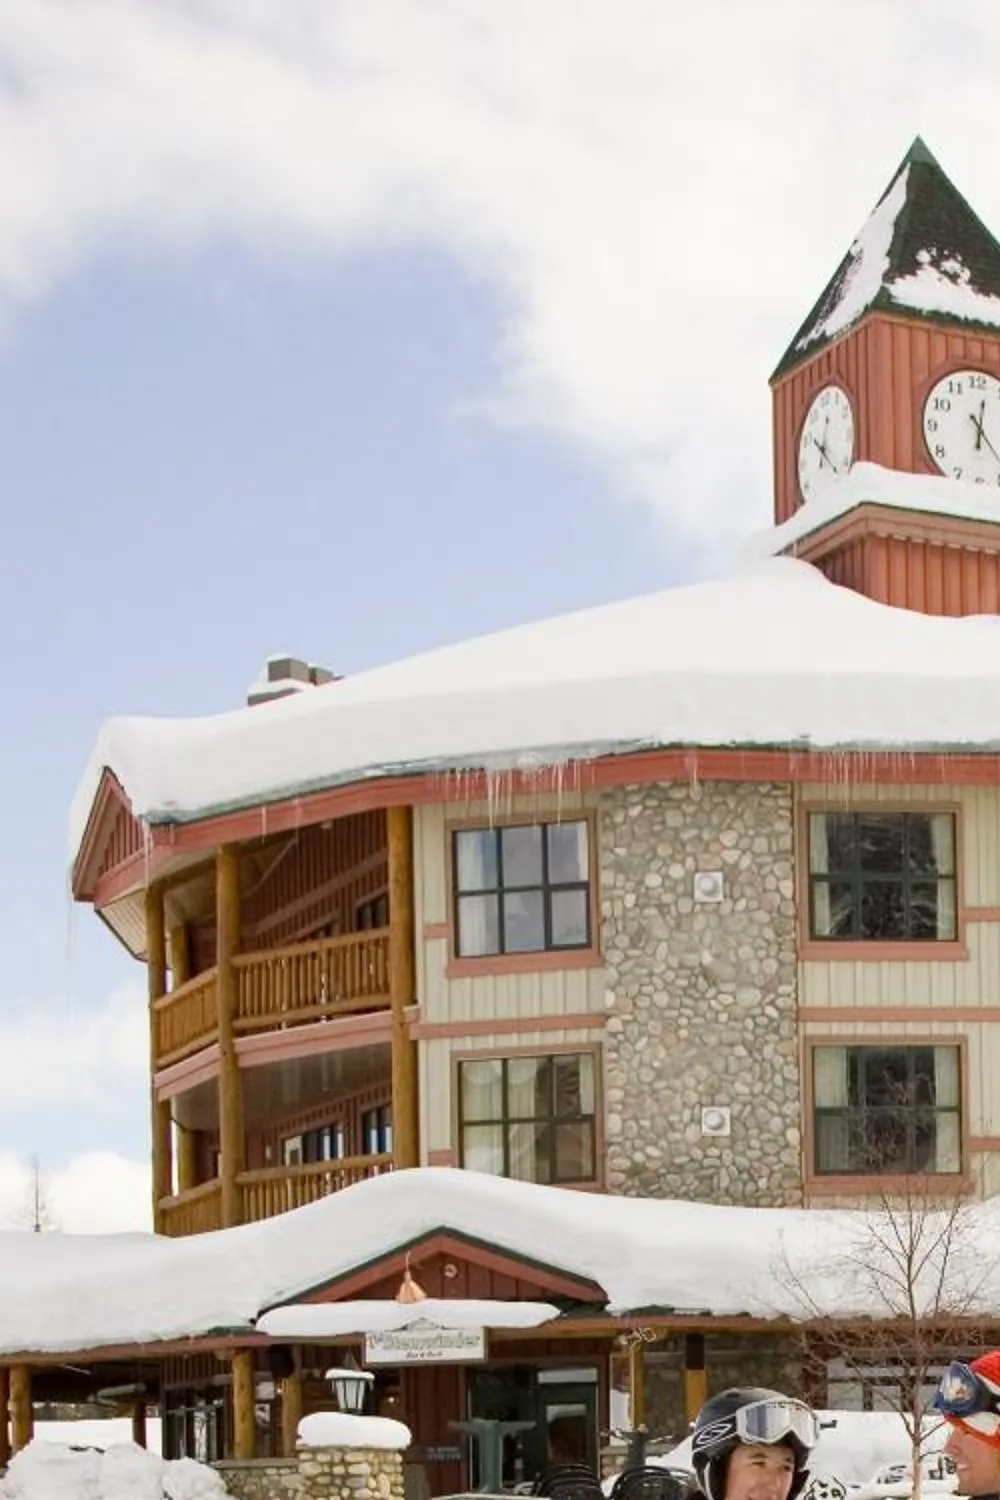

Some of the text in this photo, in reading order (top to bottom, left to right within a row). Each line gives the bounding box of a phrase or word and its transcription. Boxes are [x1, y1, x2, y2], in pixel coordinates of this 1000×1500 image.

[948, 379, 962, 395] 11
[967, 376, 987, 390] 12
[934, 397, 951, 413] 10
[927, 418, 938, 432] 9
[935, 444, 945, 459] 8
[952, 466, 964, 480] 7
